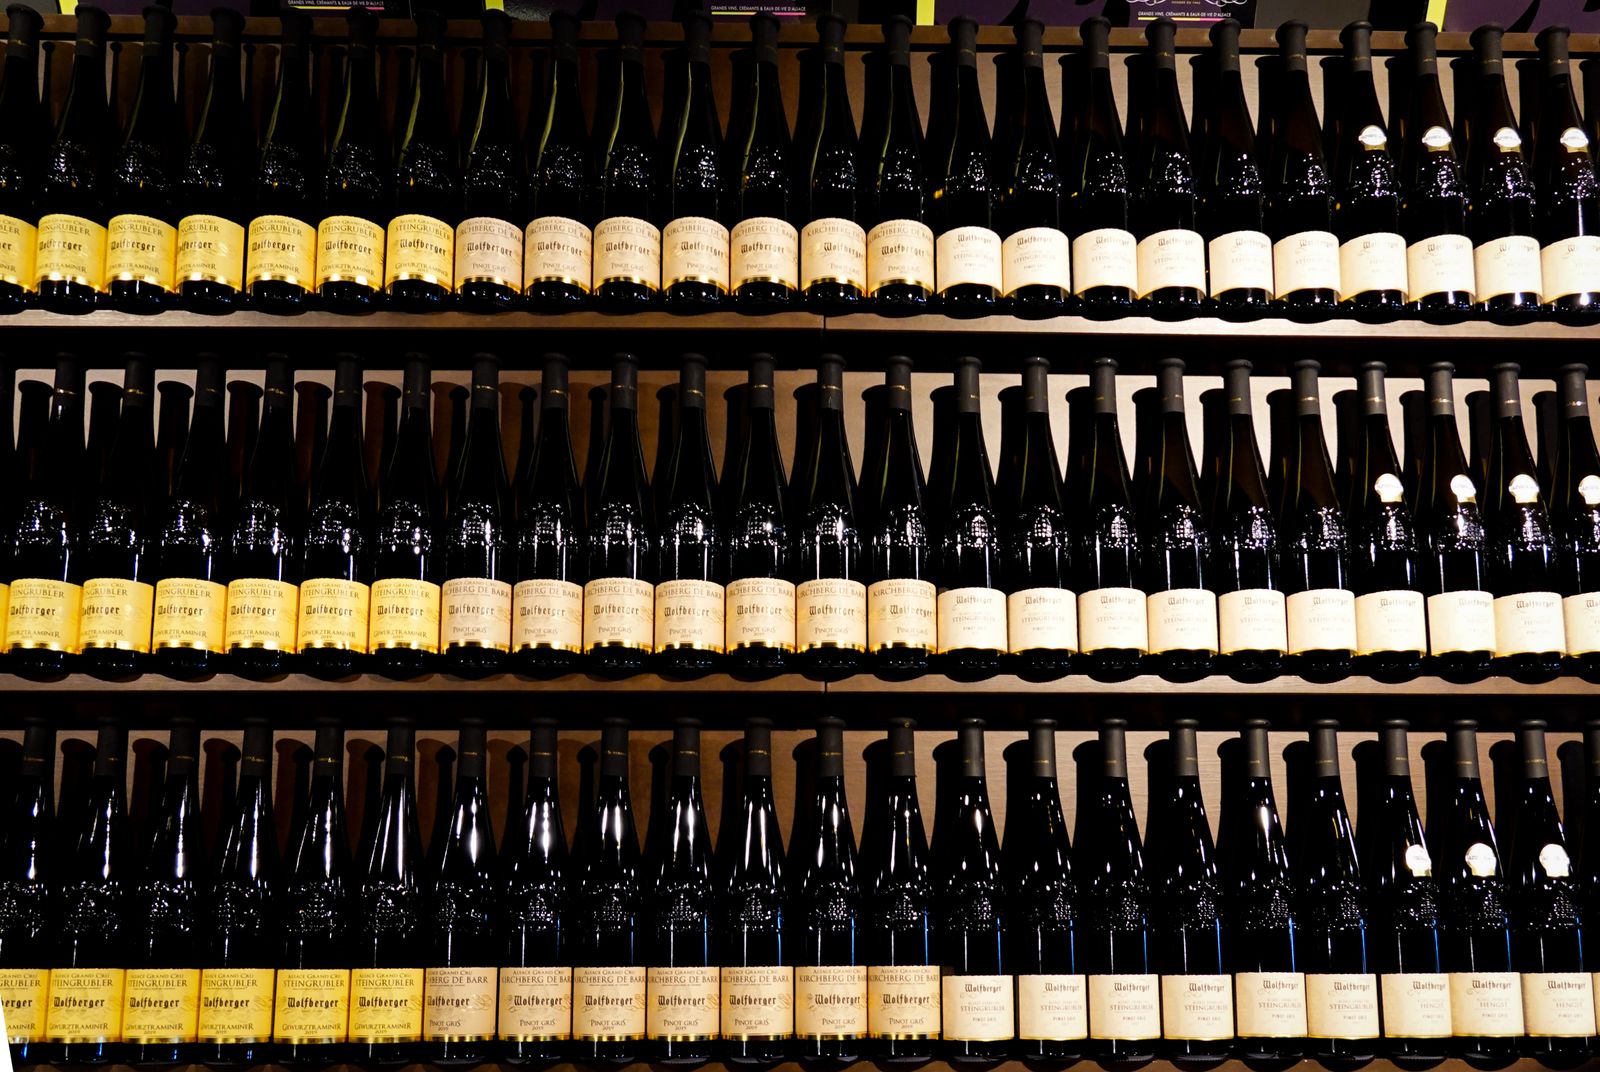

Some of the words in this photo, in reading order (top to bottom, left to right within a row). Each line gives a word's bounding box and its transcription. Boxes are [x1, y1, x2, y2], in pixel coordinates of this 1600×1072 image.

[325, 241, 371, 255] Wolfberger
[400, 238, 446, 256] Wolfberger
[467, 242, 512, 257] Wolfberger
[537, 242, 582, 256] Wolfberger
[605, 241, 650, 256] Wolfberger
[681, 241, 723, 257] Wolfberger
[741, 241, 784, 254] Wolfberger
[881, 244, 925, 257] Wolfberger
[956, 595, 993, 604] Wolfberger
[1025, 596, 1062, 605] Wolfberger
[1100, 596, 1136, 605] Wolfberger
[1168, 597, 1204, 606] Wolfberger
[306, 604, 353, 616] Wolfberger
[377, 605, 424, 616] Wolfberger
[448, 604, 494, 615] Wolfberger
[520, 605, 565, 616] Wolfberger
[594, 605, 639, 615] Wolfberger
[664, 606, 709, 616] Wolfberger
[736, 605, 782, 615] Wolfberger
[809, 605, 855, 616] Wolfberger
[889, 605, 932, 617] Wolfberger
[759, 975, 771, 983] DE
[1472, 980, 1511, 989] Wolfberger
[964, 984, 1002, 993] Wolfberger
[1044, 983, 1080, 992] Wolfberger
[1114, 982, 1150, 992] Wolfberger
[1188, 983, 1224, 992] Wolfberger
[1263, 980, 1298, 990] Wolfberger
[1334, 981, 1370, 991] Wolfberger
[1412, 980, 1446, 990] Wolfberger
[1547, 980, 1586, 990] Wolfberger
[54, 996, 104, 1008] Wolfberger
[129, 996, 179, 1008] Wolfberger
[287, 996, 338, 1008] Wolfberger
[359, 996, 408, 1008] Wolfberger
[514, 995, 563, 1007] Wolfberger
[585, 995, 633, 1006] Wolfberger
[658, 994, 705, 1007] Wolfberger
[729, 994, 776, 1006] Wolfberger
[815, 994, 860, 1005] Wolfberger
[883, 994, 929, 1005] Wolfberger
[519, 1019, 540, 1027] PINOT
[822, 1018, 841, 1026] PINOT
